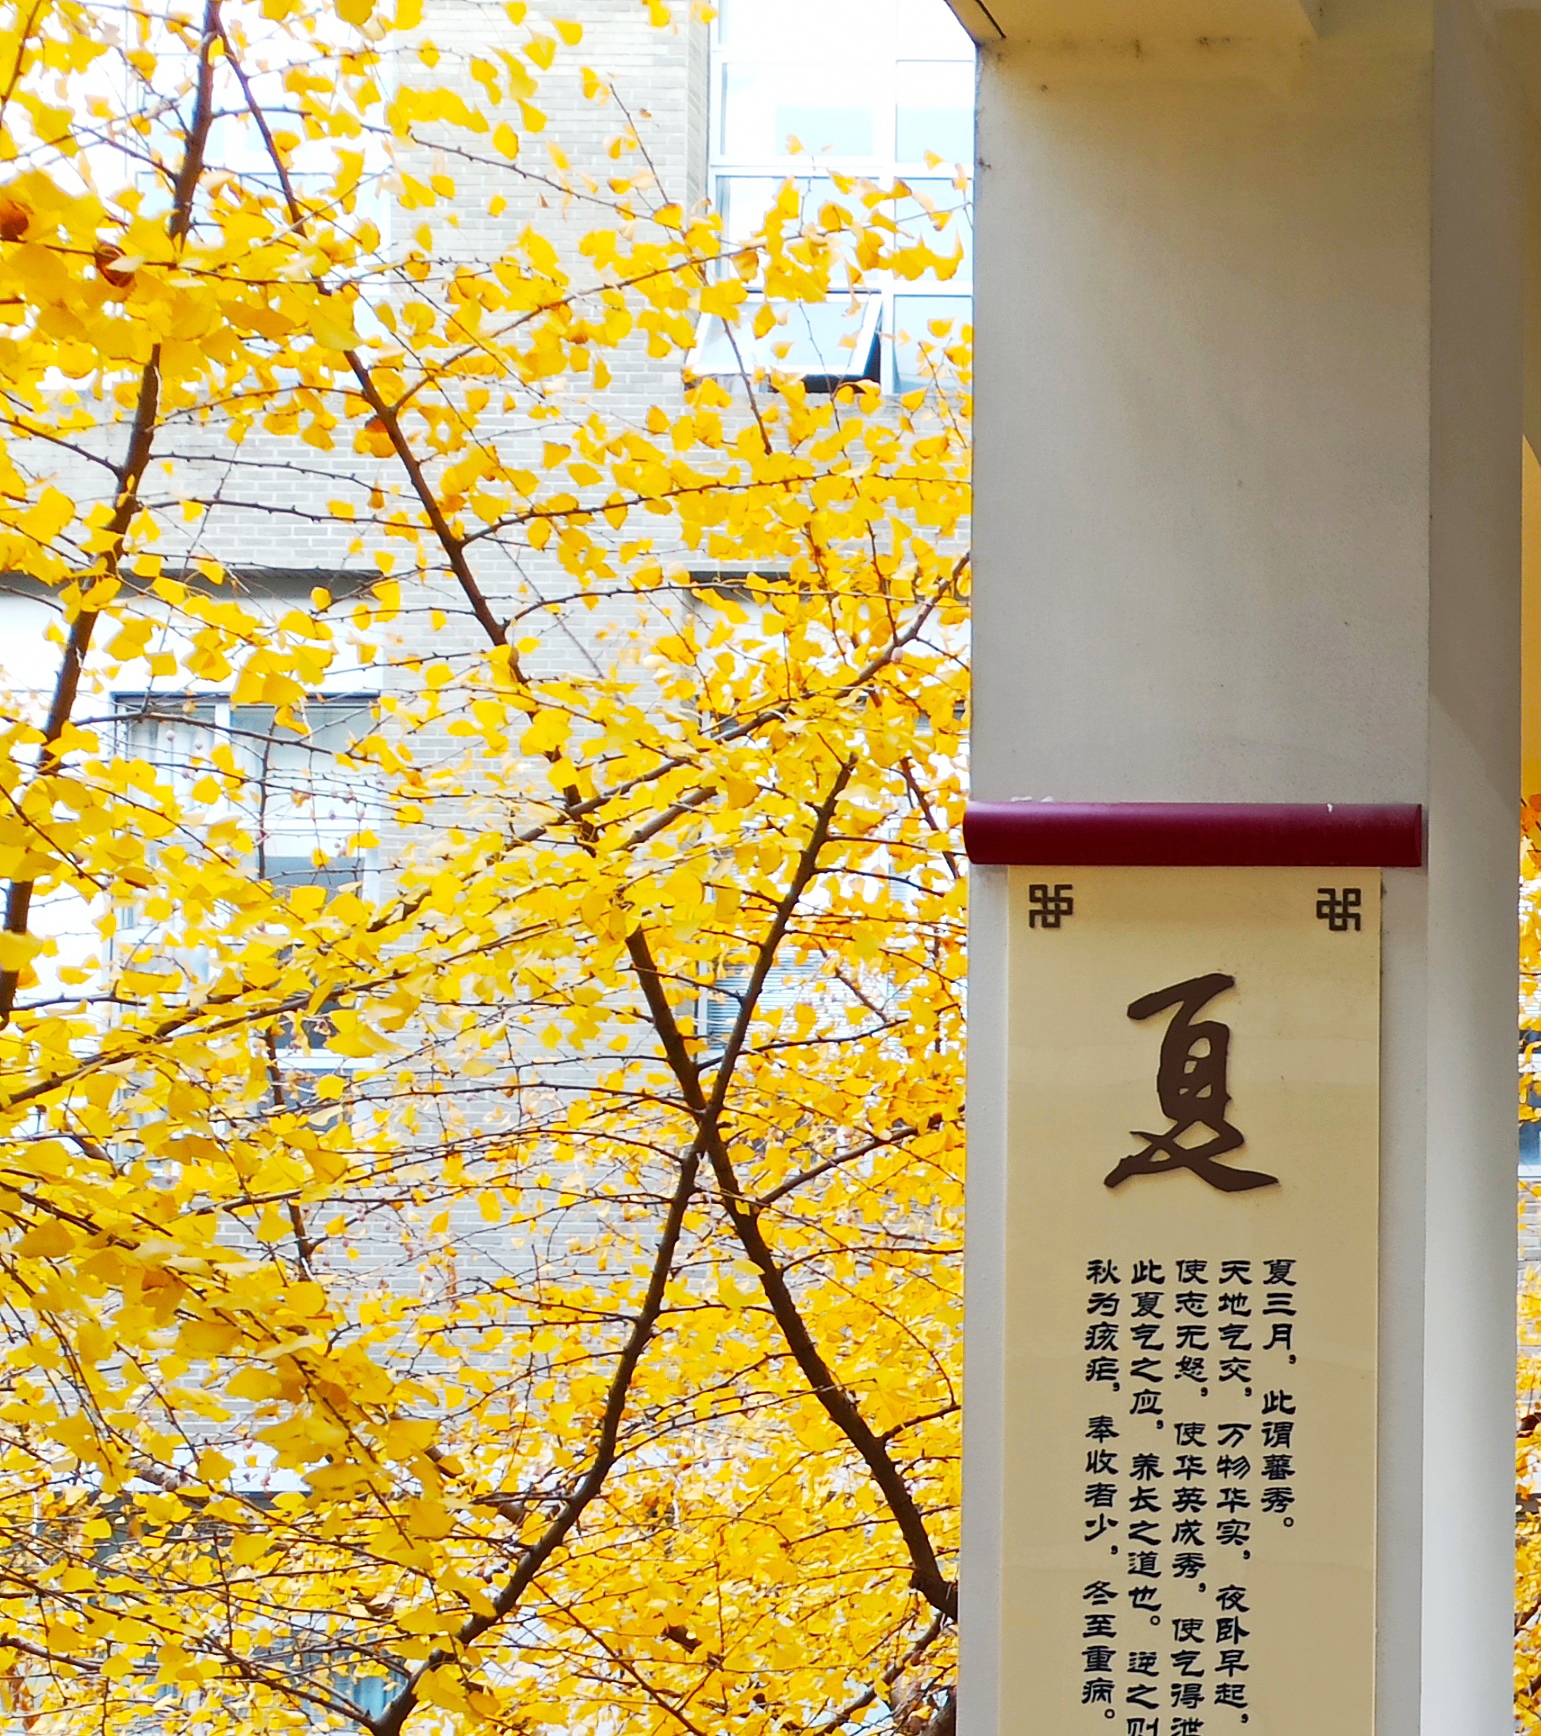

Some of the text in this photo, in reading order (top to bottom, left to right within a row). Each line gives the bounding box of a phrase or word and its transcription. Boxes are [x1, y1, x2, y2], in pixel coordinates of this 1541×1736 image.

[1103, 972, 1281, 1192] 夏
[1261, 1259, 1297, 1527] 夏三月，此谓蕃秀。
